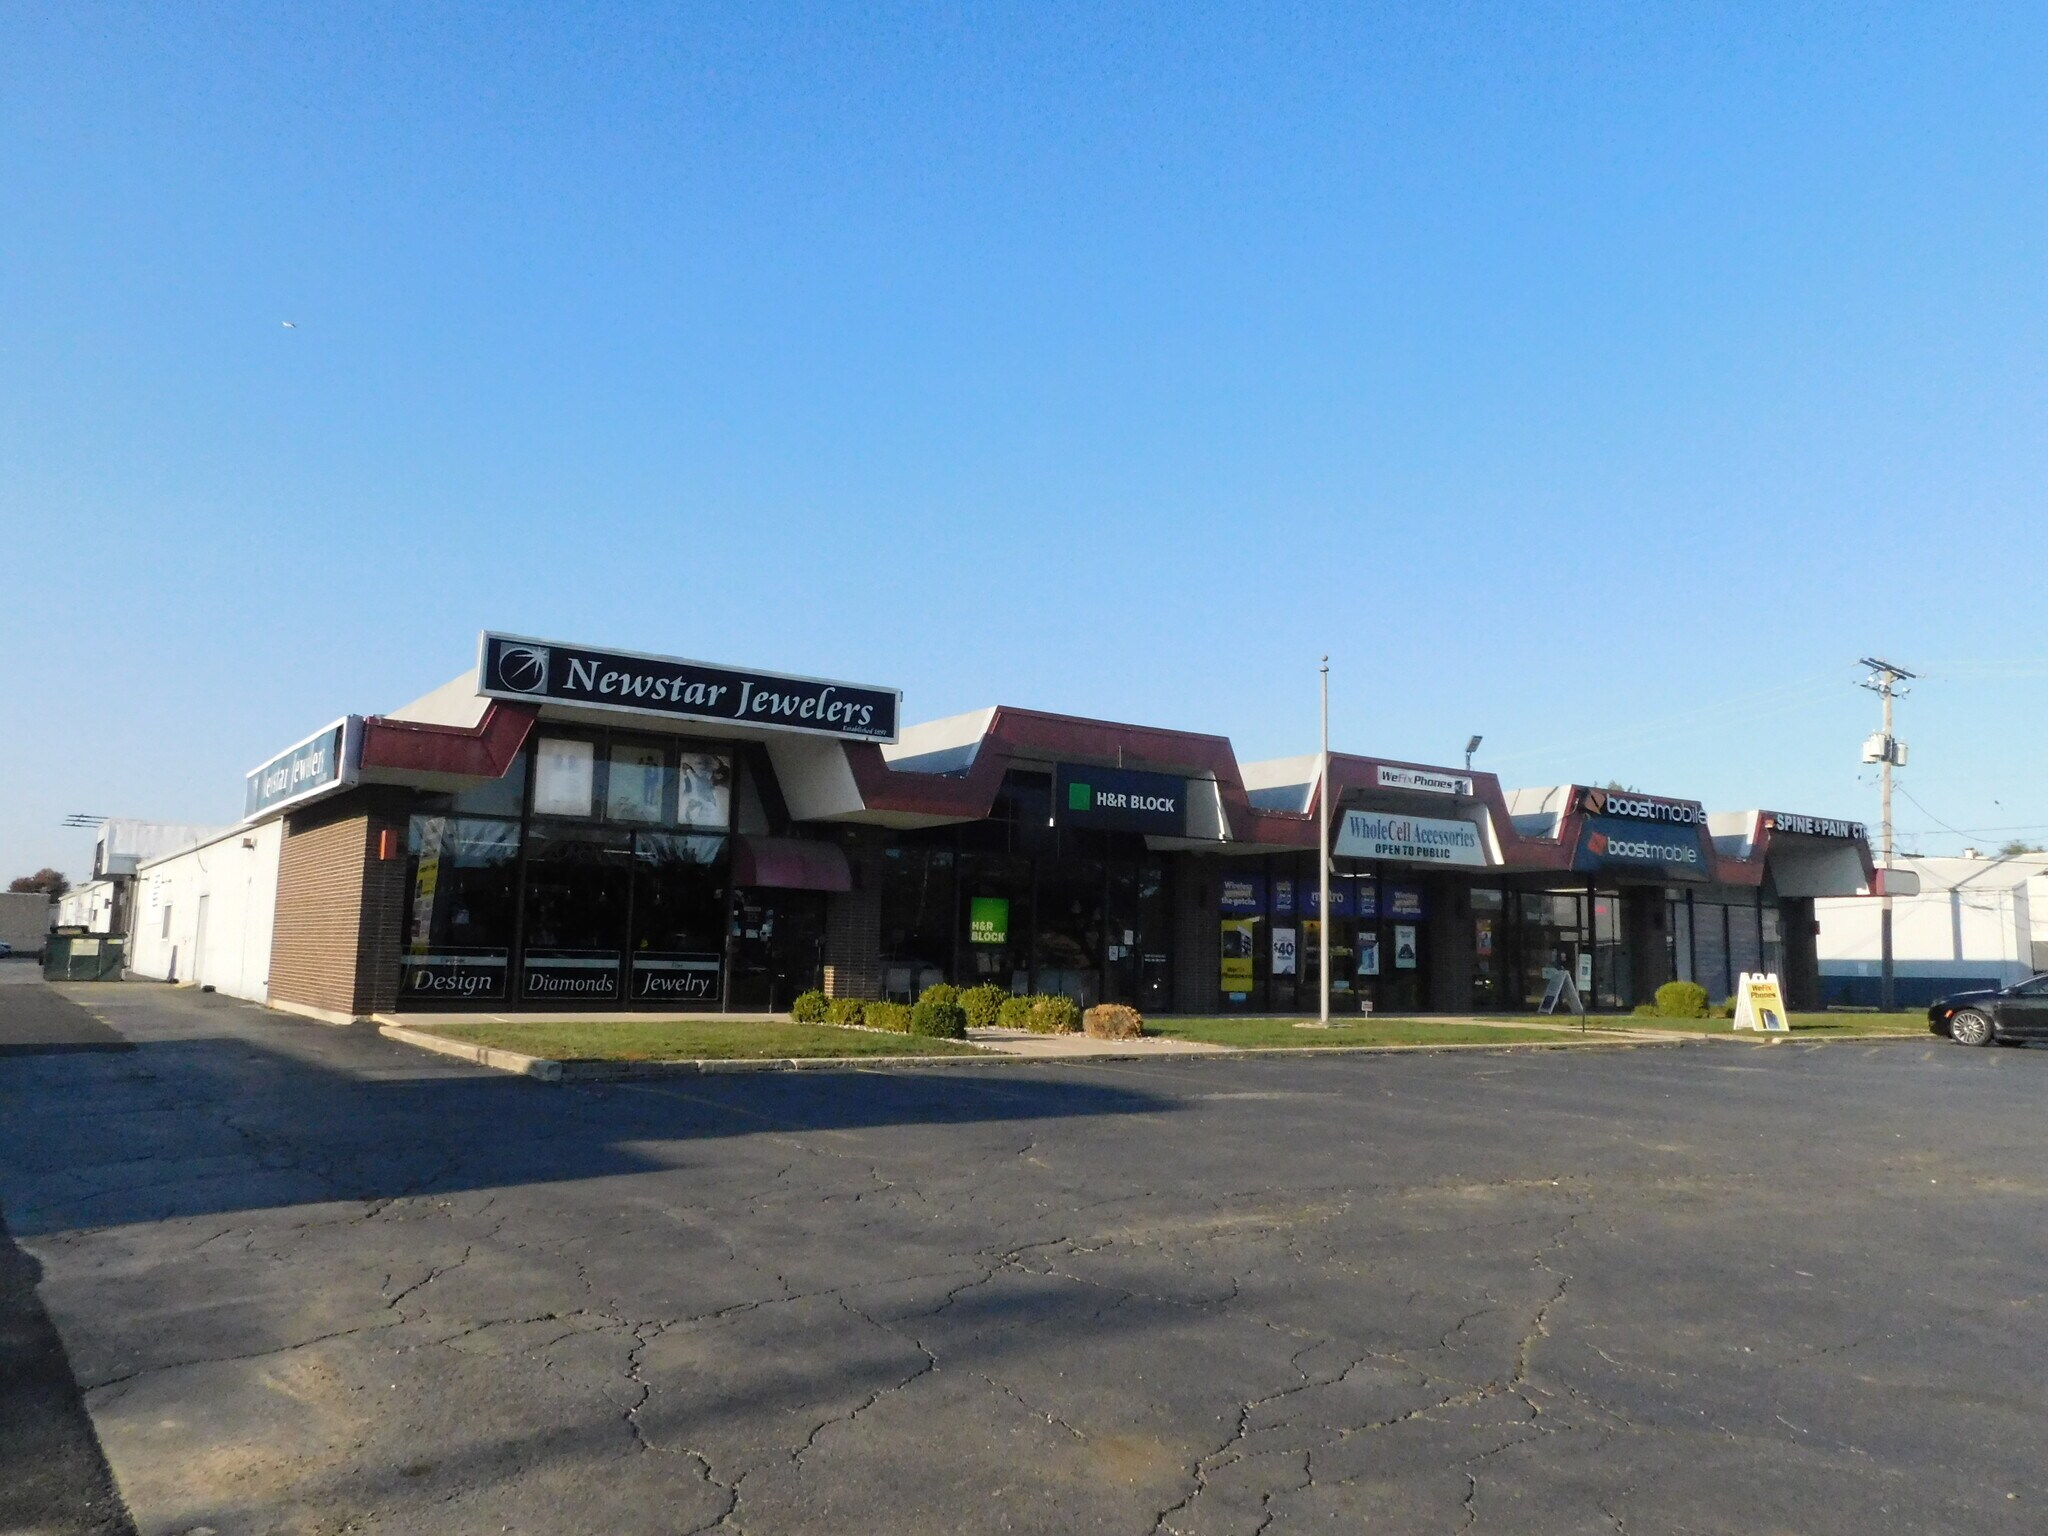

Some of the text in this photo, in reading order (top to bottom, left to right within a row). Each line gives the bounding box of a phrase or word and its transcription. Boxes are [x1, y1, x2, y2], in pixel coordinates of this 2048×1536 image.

[562, 657, 874, 726] Newstar Jewelers
[260, 767, 289, 798] estar
[1096, 791, 1175, 813] H&R BLOCK
[1350, 816, 1475, 848] WholeCell Accessories
[1776, 814, 1814, 835] SPINE
[1813, 821, 1821, 833] &
[1821, 820, 1850, 838] PAIN
[1375, 843, 1451, 859] OPEN TO PUBLIC
[1310, 889, 1344, 904] mtro
[970, 931, 1006, 942] BLOCK
[971, 921, 994, 931] H&R
[1273, 941, 1295, 957] $40
[413, 970, 493, 996] Design
[528, 973, 615, 992] Diamonds
[640, 972, 710, 997] Jewelry
